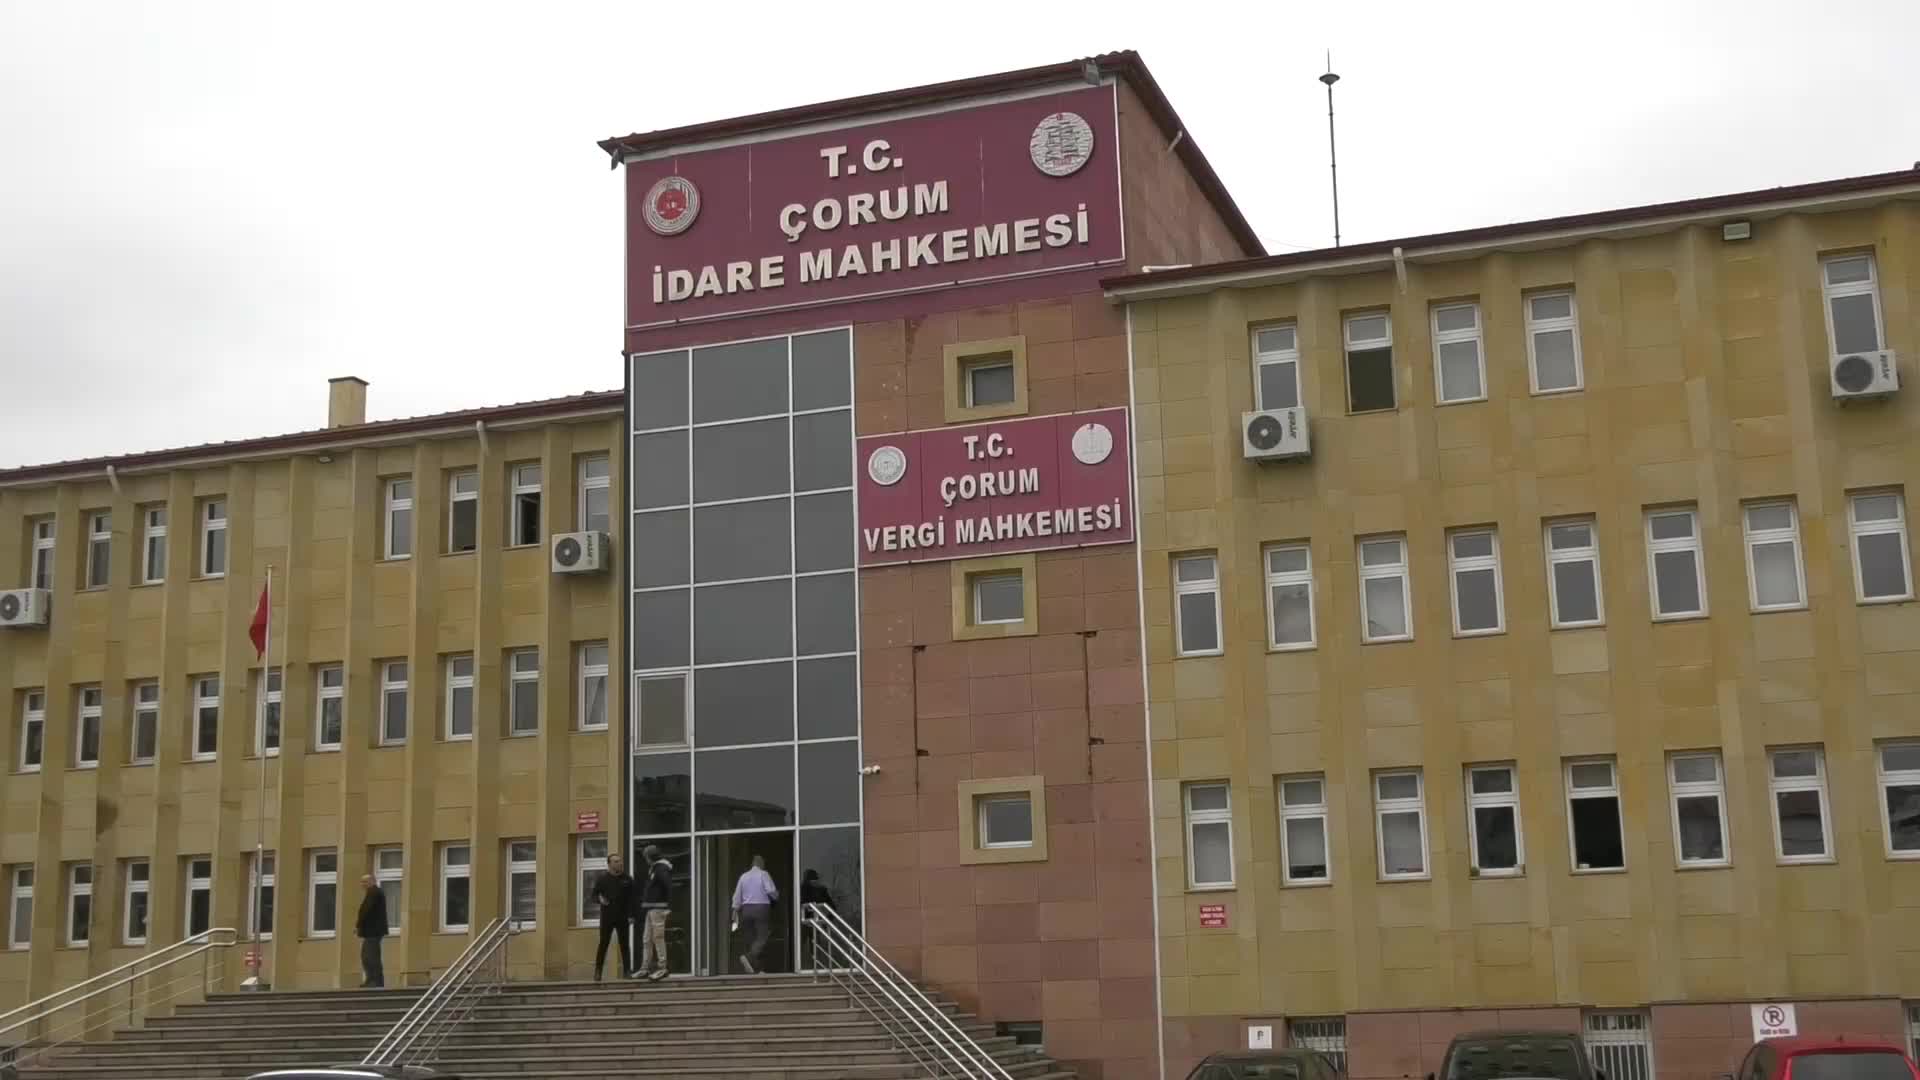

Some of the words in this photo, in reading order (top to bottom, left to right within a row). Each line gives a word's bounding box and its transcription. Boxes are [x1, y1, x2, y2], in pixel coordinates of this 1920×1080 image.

[820, 139, 903, 178] T.C.
[779, 180, 948, 242] ÇORUM
[652, 256, 785, 303] İDARE
[799, 203, 1089, 283] MAHKEMESİ
[963, 433, 1014, 460] T.C.
[940, 467, 1039, 507] ÇORUM
[863, 515, 945, 552] VERGİ
[955, 497, 1121, 544] MAHKEMESİ
